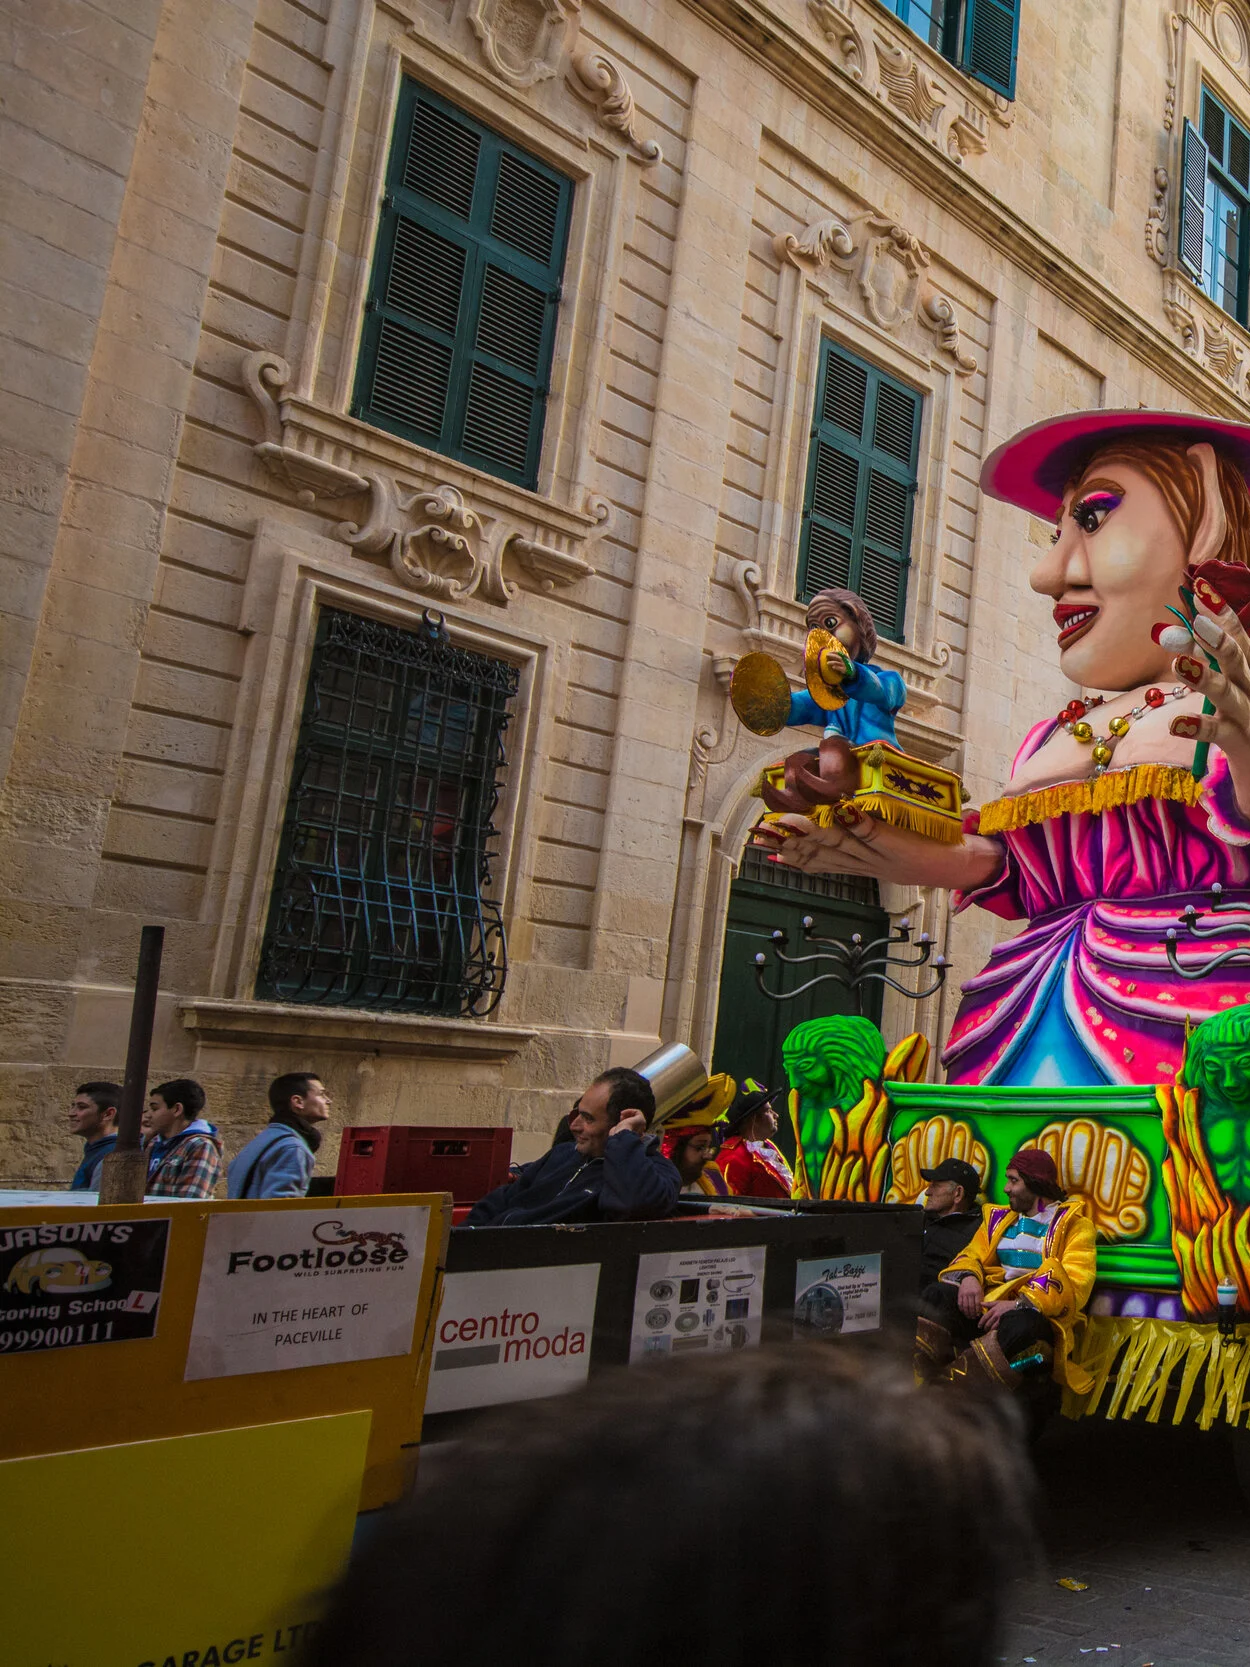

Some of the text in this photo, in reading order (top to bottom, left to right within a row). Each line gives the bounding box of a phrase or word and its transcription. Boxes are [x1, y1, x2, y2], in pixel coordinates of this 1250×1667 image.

[0, 1223, 133, 1251] JASON'S
[226, 1246, 409, 1276] Footloose
[324, 1266, 382, 1276] SURPRISING
[252, 1303, 369, 1325] IN THE HEART OF
[440, 1308, 540, 1344] centro
[274, 1328, 343, 1346] PACEVILLE
[504, 1326, 586, 1363] moda
